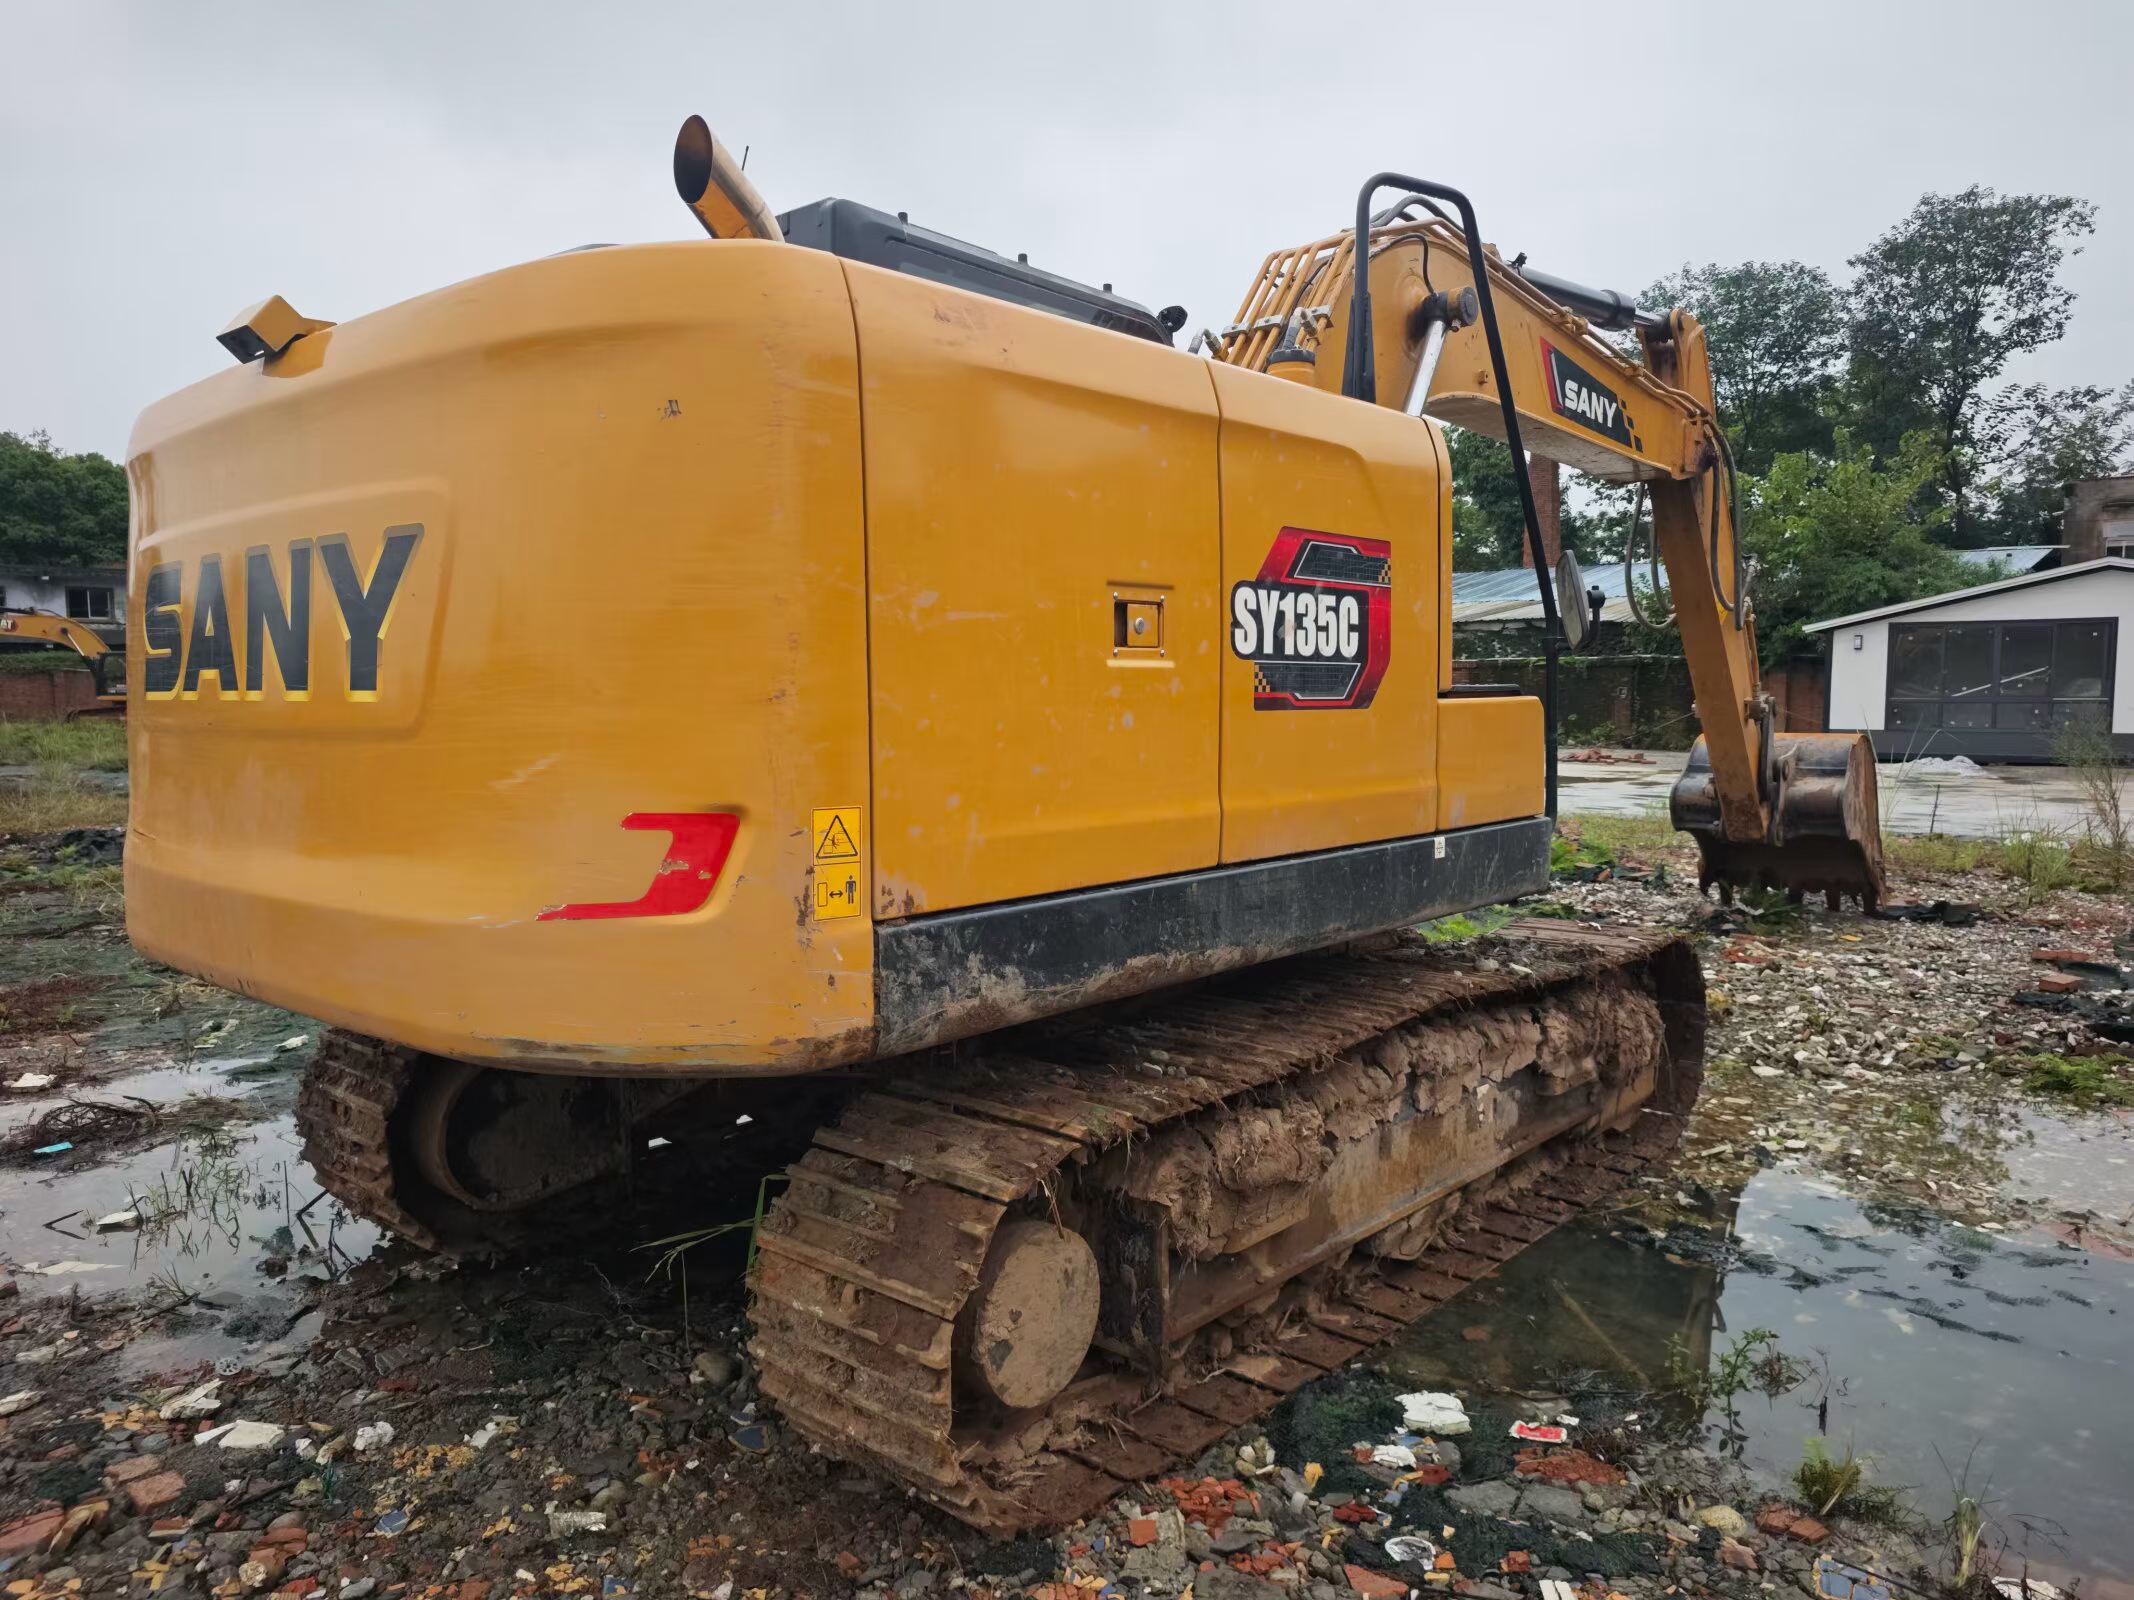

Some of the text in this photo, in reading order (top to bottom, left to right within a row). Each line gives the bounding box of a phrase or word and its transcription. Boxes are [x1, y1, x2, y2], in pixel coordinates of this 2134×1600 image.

[1564, 379, 1617, 428] SANY
[144, 523, 424, 702] SANY
[1234, 586, 1359, 658] SY135C
